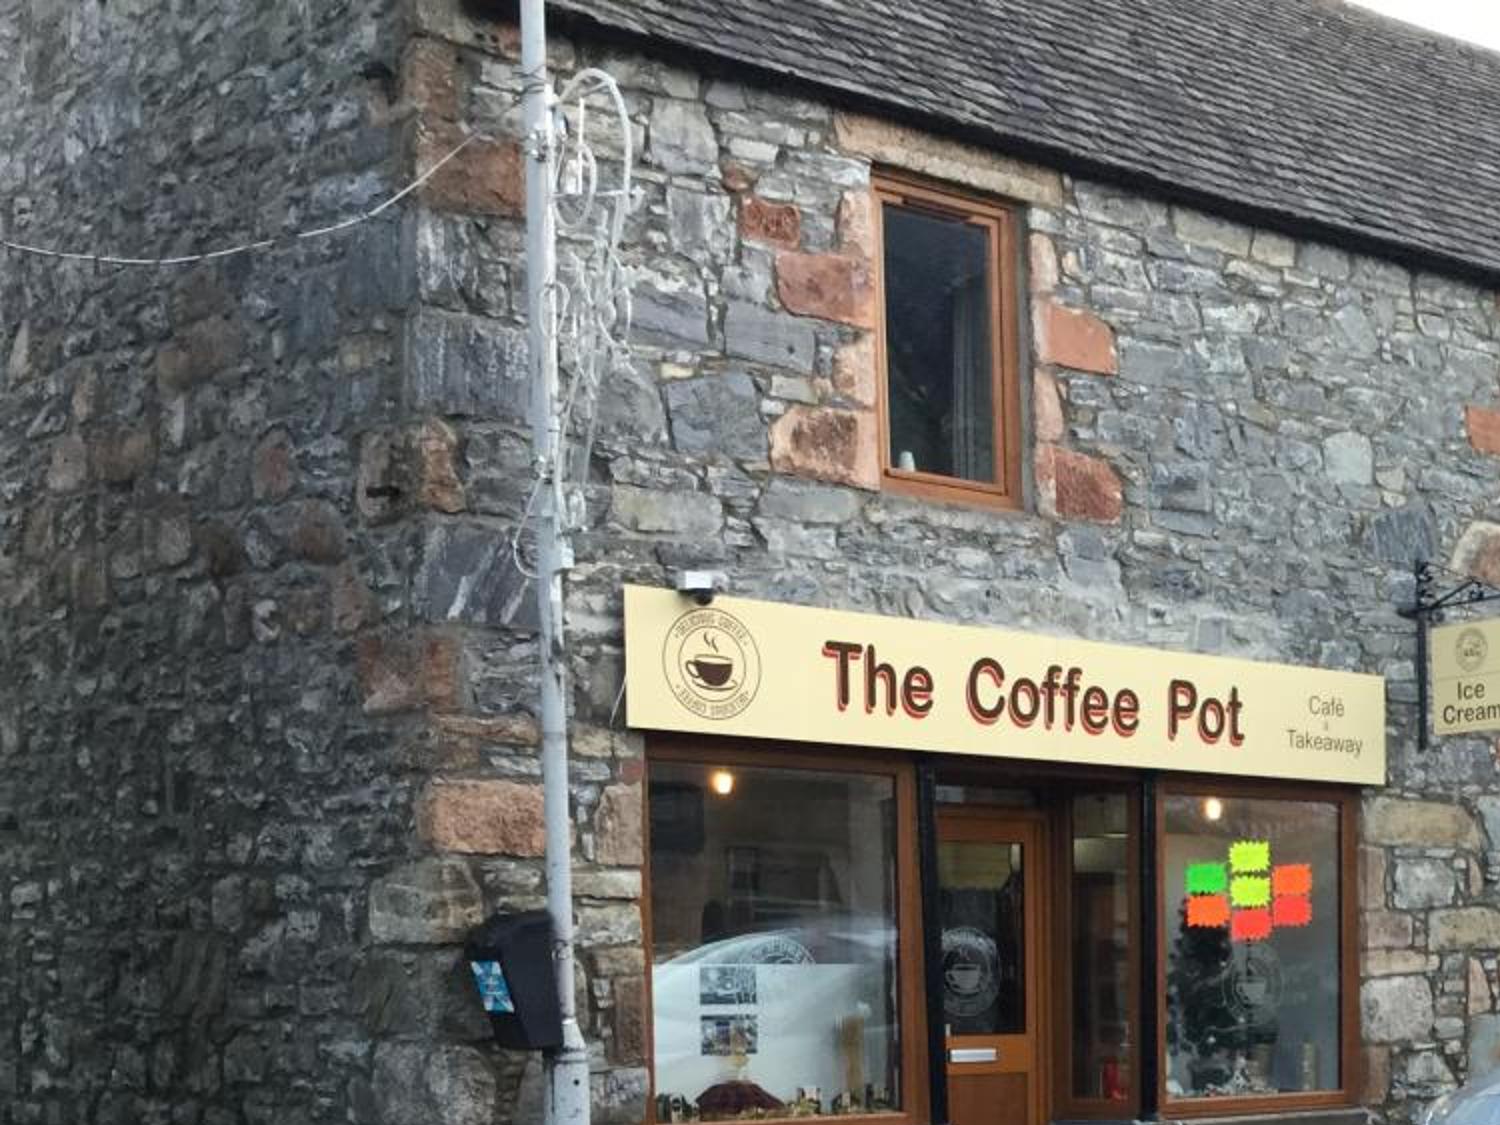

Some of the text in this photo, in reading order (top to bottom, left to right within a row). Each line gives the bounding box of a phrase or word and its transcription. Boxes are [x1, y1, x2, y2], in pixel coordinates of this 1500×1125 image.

[821, 639, 1246, 747] The Coffee Pot
[1457, 681, 1485, 700] Ice
[1286, 728, 1363, 759] Takeaway
